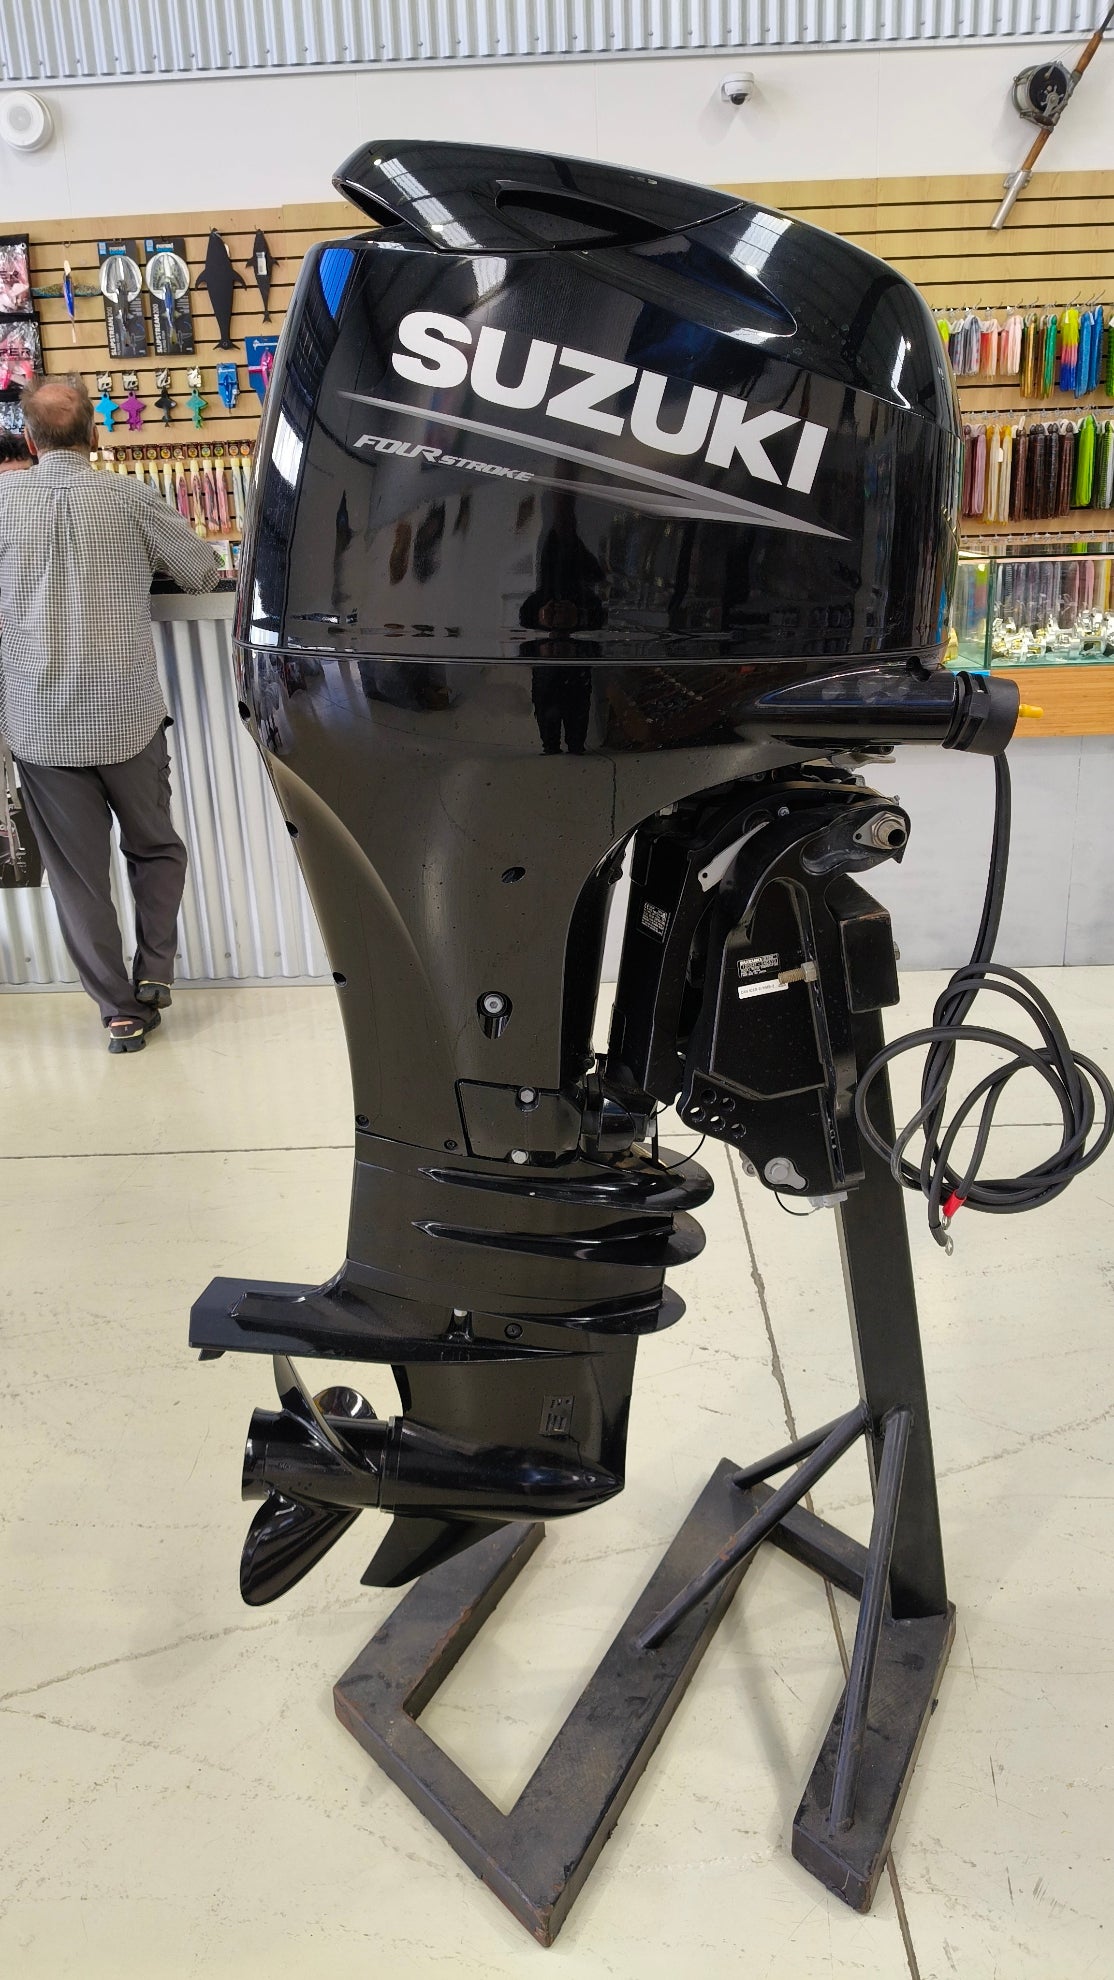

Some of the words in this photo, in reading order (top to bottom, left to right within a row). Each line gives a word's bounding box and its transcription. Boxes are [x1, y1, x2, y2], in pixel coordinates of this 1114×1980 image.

[153, 315, 163, 353] SLIPSTREAM
[392, 311, 829, 495] SUZUKI
[353, 434, 443, 463] FOUR
[437, 455, 534, 482] STROKE
